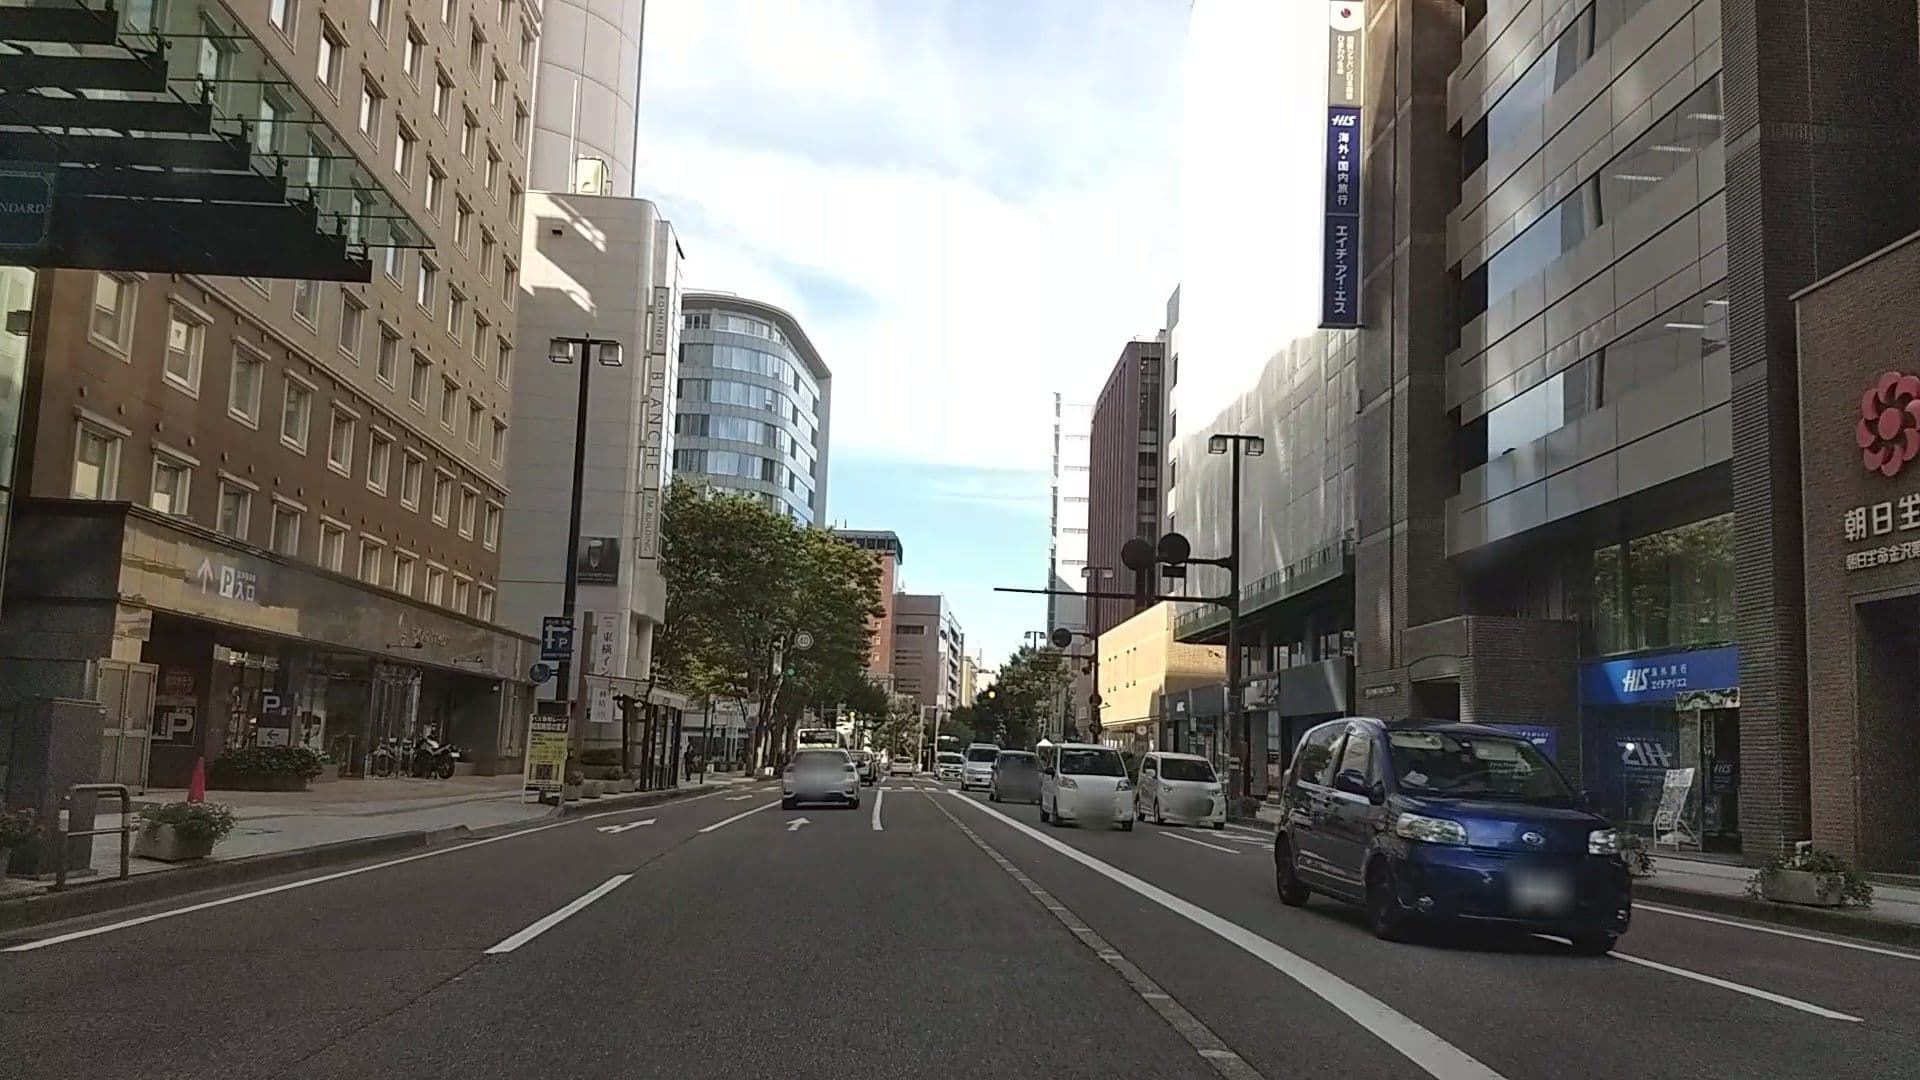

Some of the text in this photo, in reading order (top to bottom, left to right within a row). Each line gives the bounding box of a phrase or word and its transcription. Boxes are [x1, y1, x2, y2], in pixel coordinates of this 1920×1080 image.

[1331, 115, 1356, 126] HIS
[1338, 132, 1350, 205] 海外・国内旅行
[1334, 225, 1348, 313] エイチ・アイ・エス
[646, 372, 664, 470] BLANCHE
[235, 582, 255, 602] 入口
[559, 638, 568, 649] P
[1622, 668, 1649, 693] HIS
[263, 695, 281, 714] P
[167, 712, 193, 740] P
